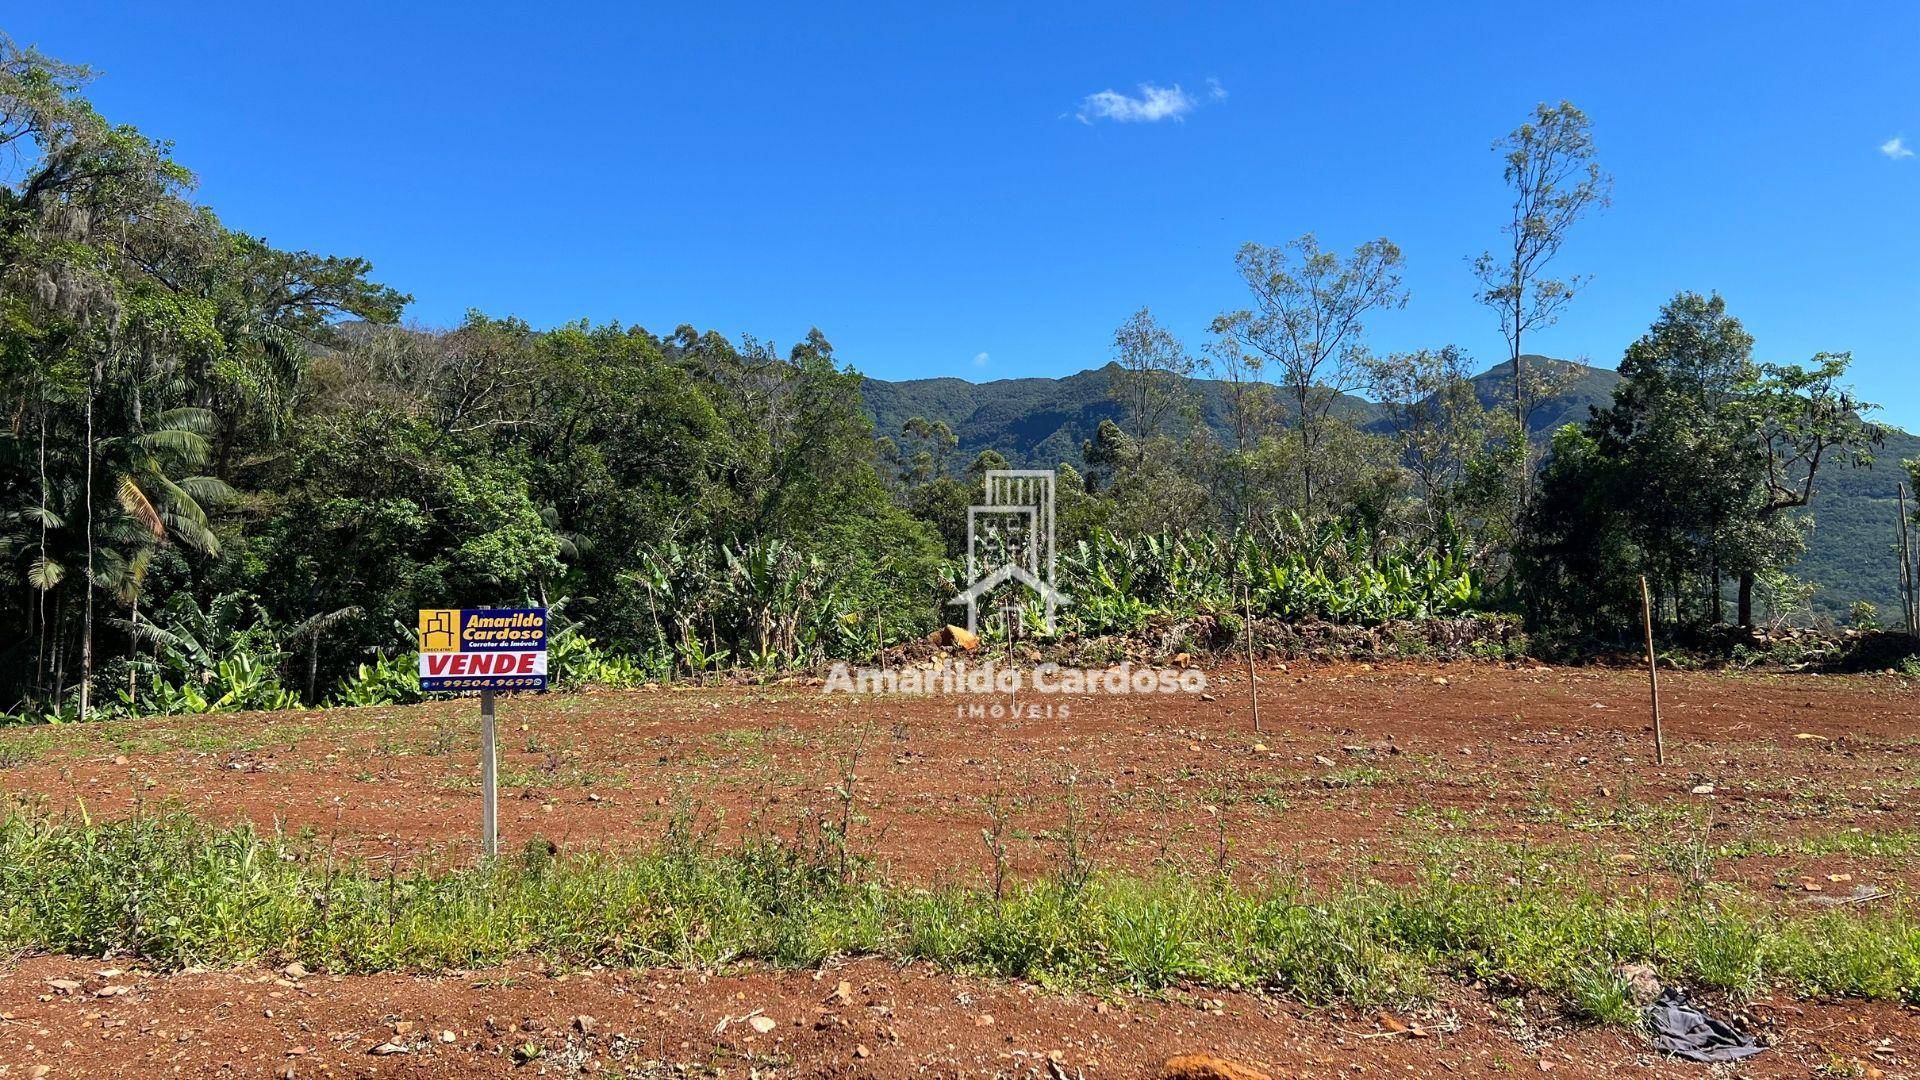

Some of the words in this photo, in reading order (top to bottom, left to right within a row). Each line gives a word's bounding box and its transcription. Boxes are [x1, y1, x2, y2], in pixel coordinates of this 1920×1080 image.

[466, 613, 544, 627] Amarildo
[462, 627, 544, 640] Cardoso
[428, 653, 537, 675] VENDE
[443, 679, 534, 687] 99504.9699
